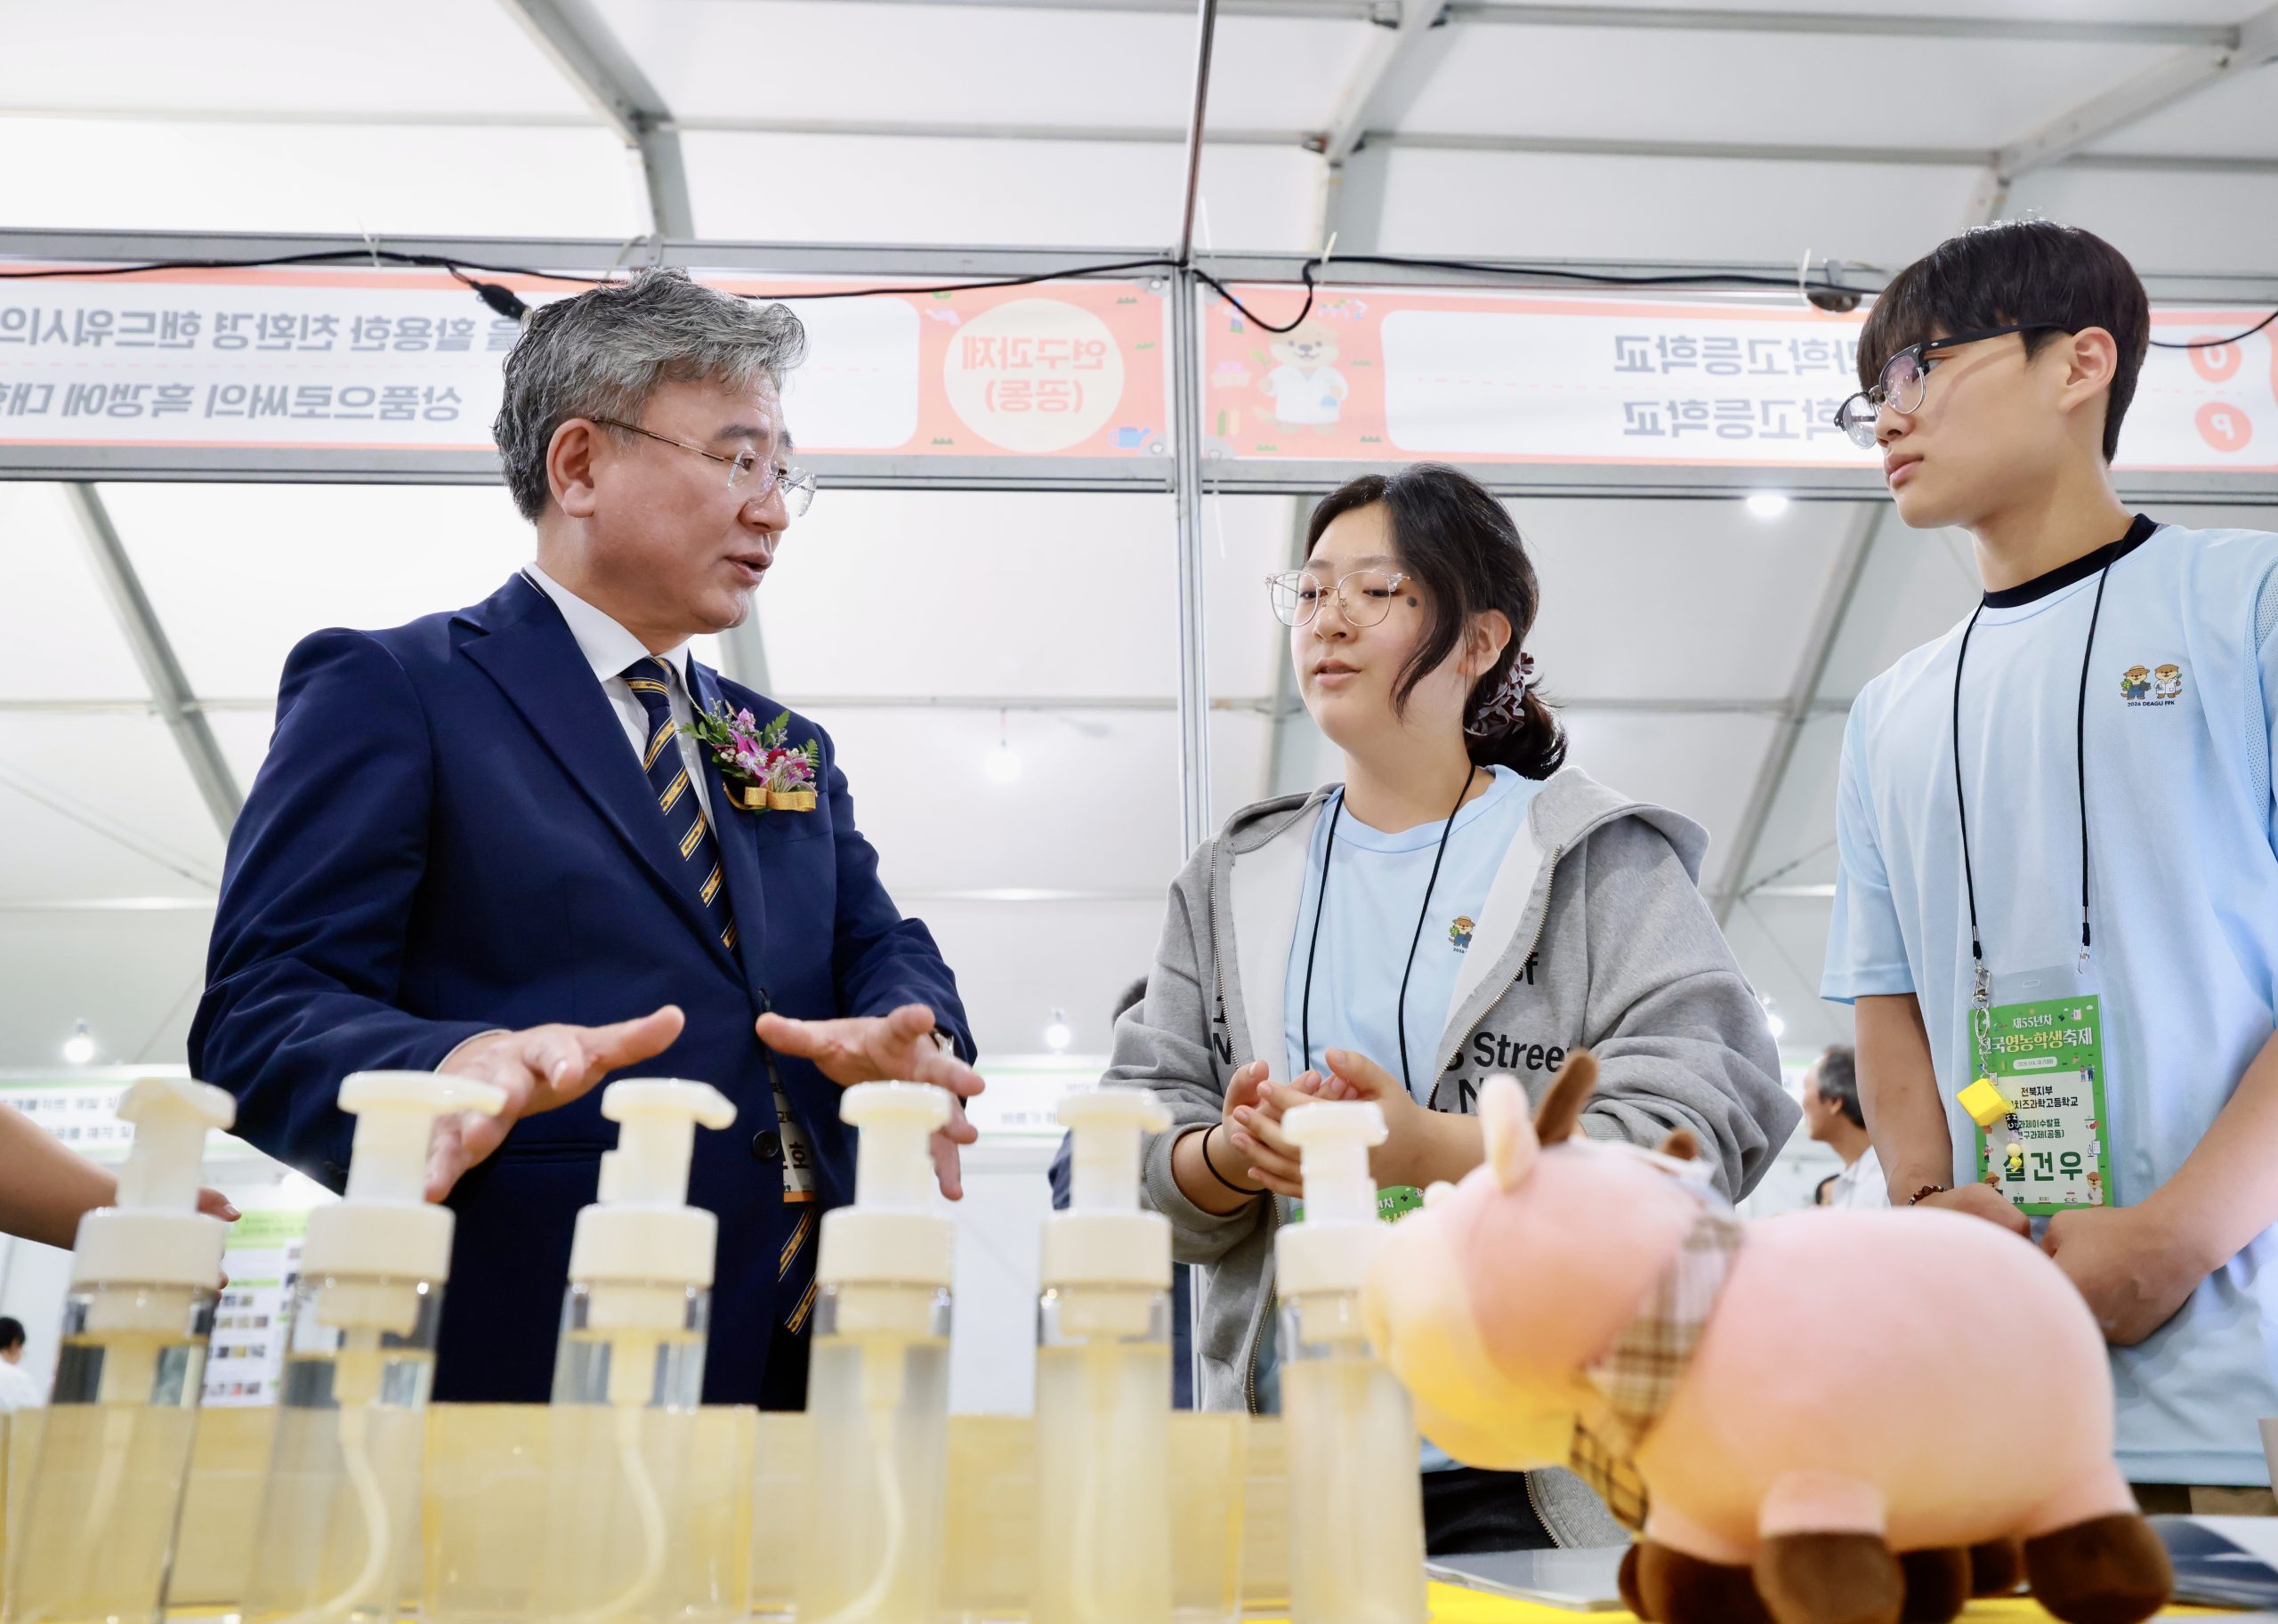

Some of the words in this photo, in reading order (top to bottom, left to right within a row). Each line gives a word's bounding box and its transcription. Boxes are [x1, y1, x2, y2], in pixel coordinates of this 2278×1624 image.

[2012, 1014, 2053, 1030] 제55년차
[1474, 1031, 1571, 1073] Stree
[2021, 1085, 2054, 1097] 전북지부
[2011, 1096, 2079, 1110] 치즈과학고등학교
